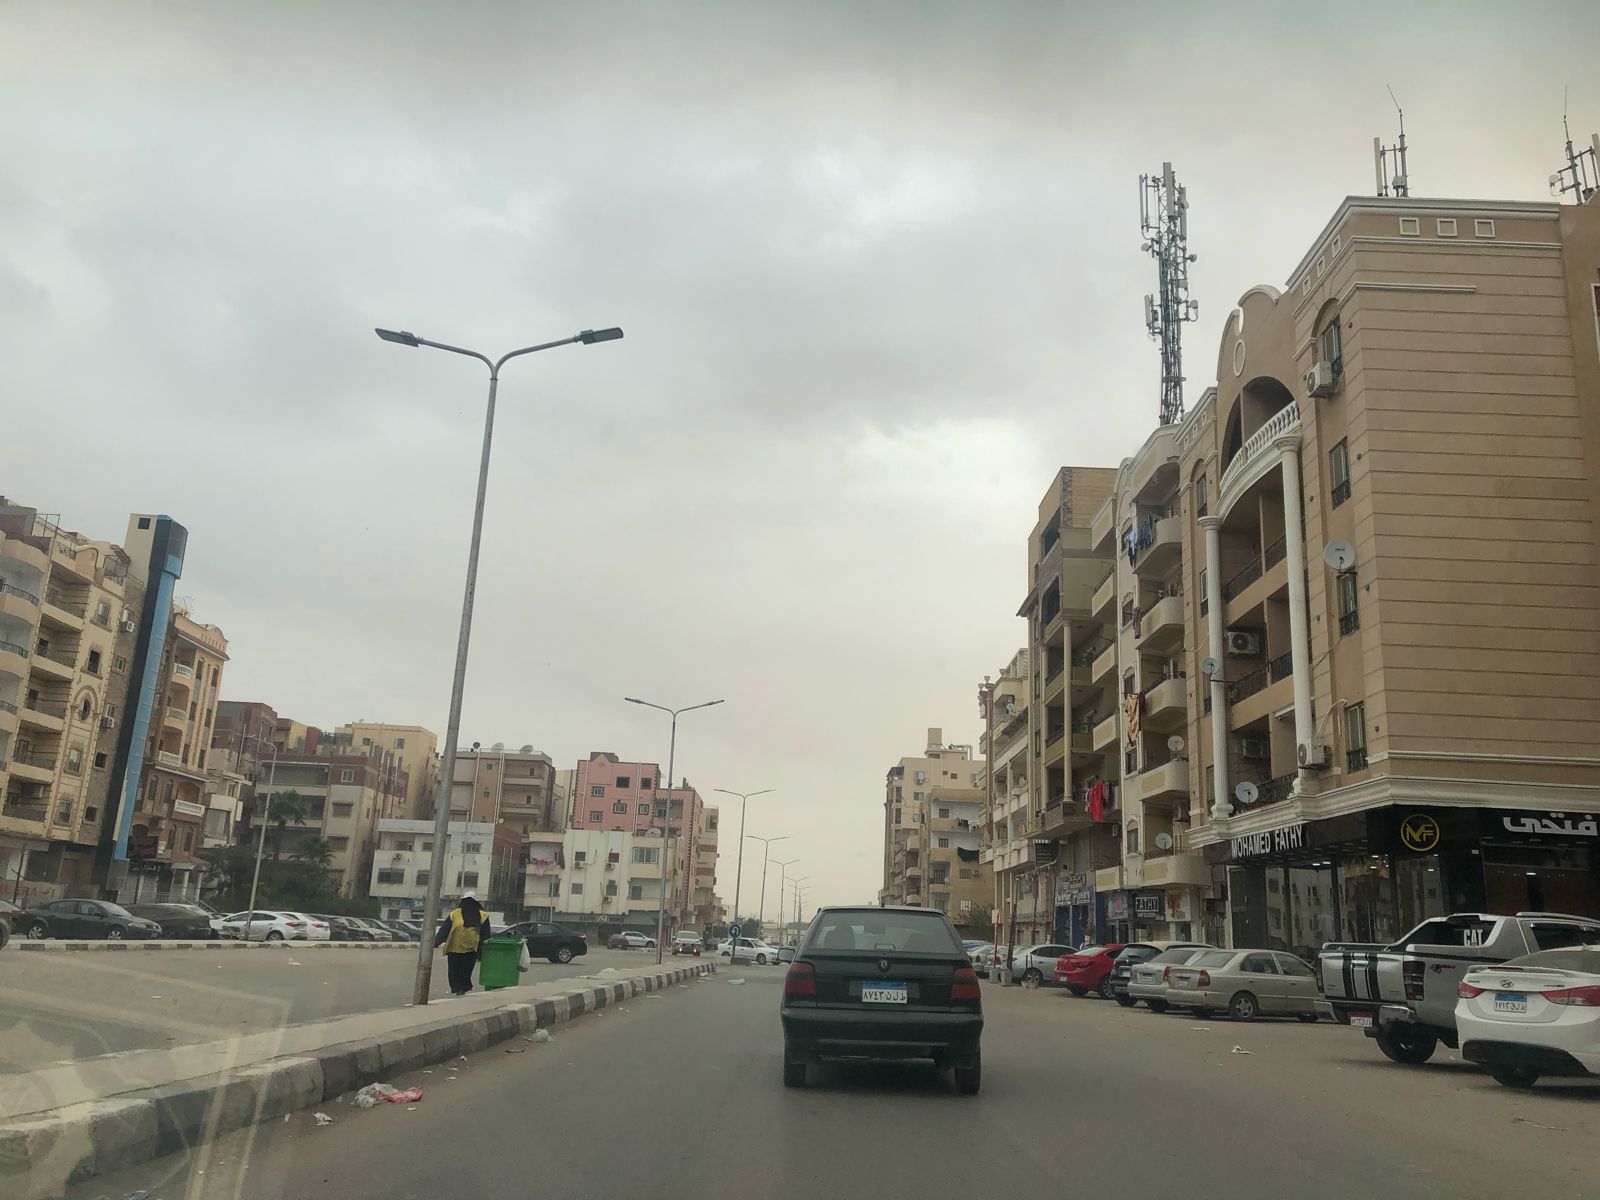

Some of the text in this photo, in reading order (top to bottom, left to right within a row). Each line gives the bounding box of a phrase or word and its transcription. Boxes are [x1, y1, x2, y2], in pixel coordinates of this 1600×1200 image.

[1232, 824, 1303, 859] MOHAMED FATHY
[1463, 929, 1483, 946] CAT
